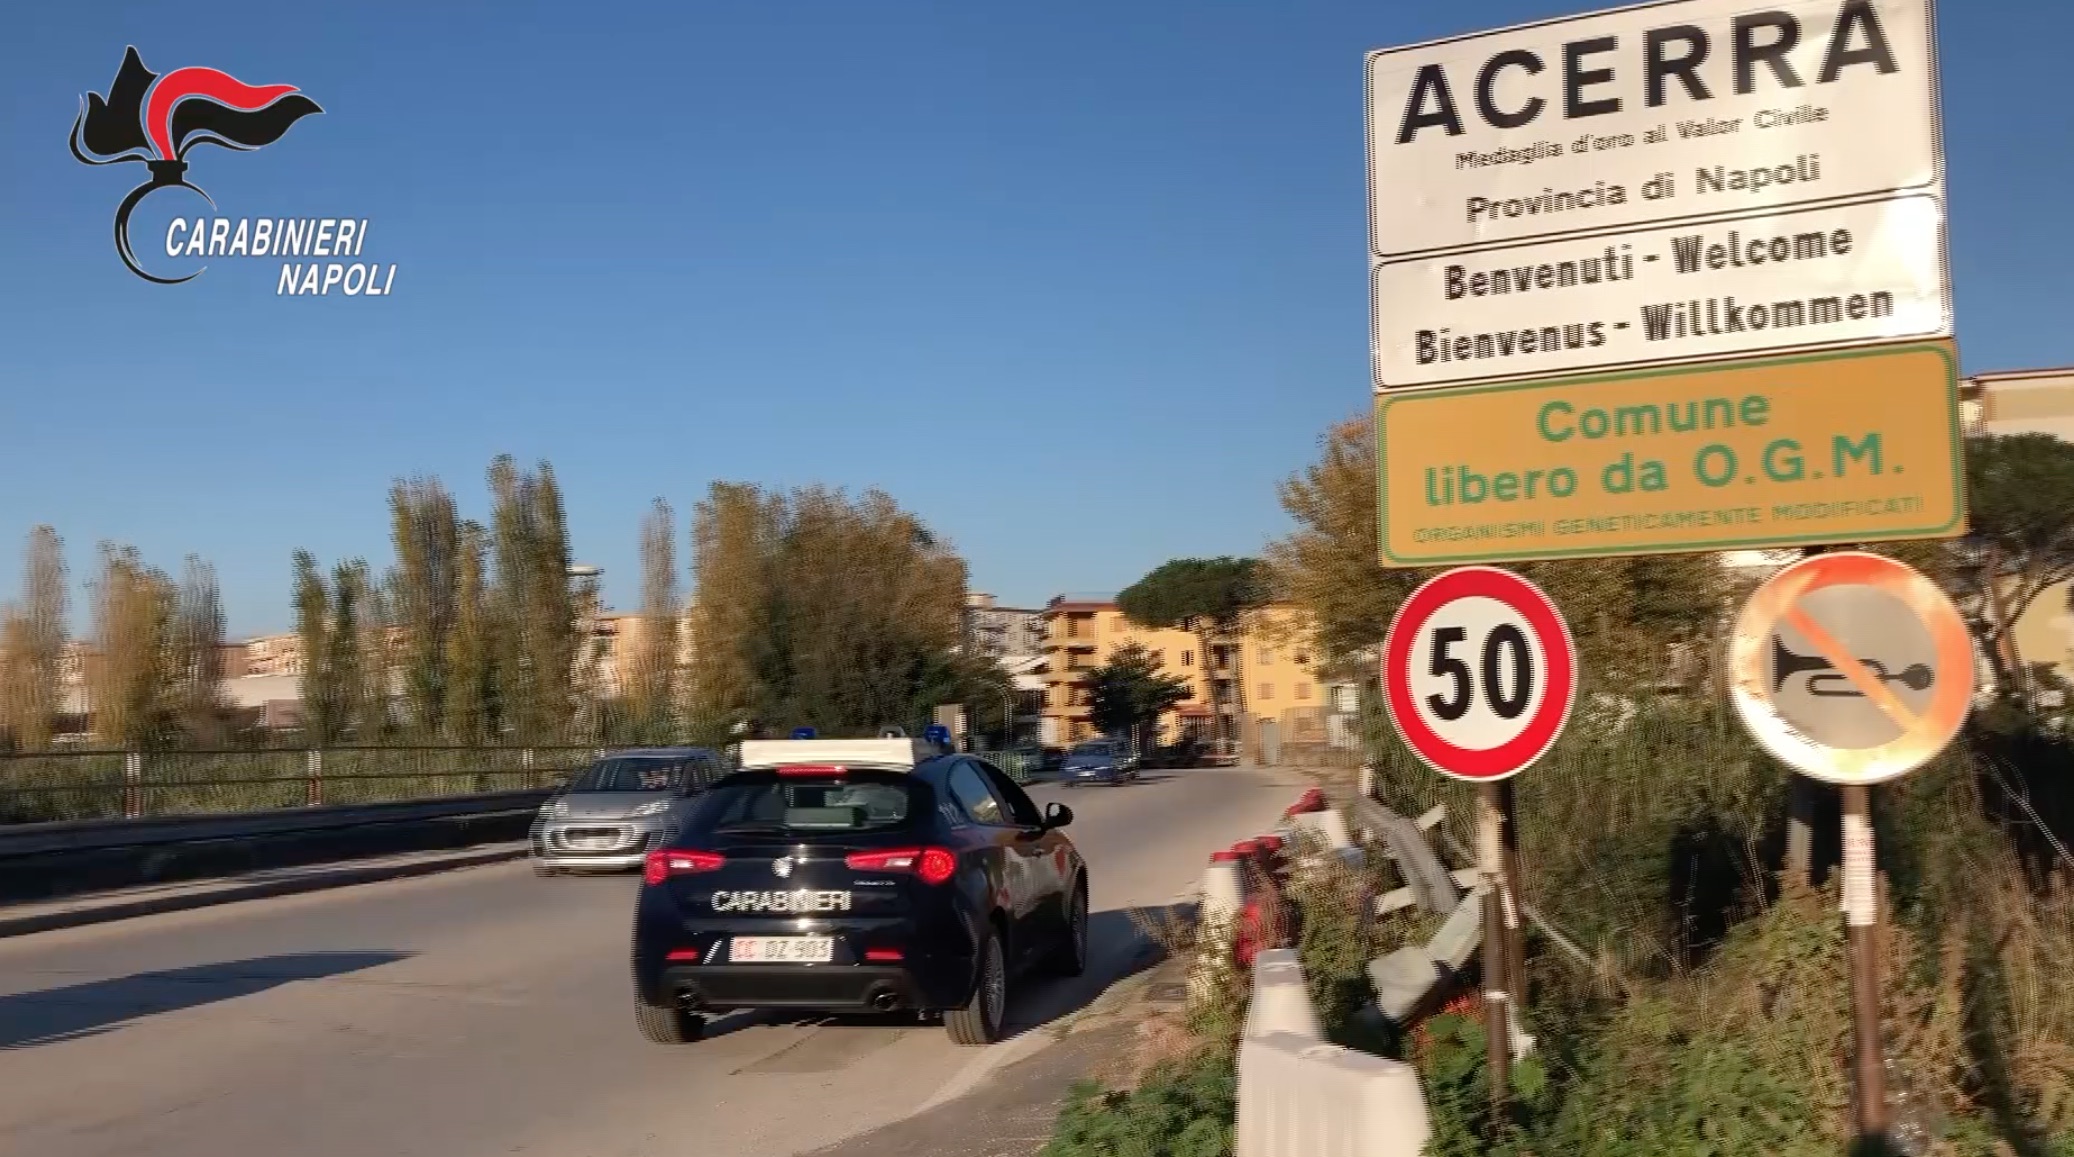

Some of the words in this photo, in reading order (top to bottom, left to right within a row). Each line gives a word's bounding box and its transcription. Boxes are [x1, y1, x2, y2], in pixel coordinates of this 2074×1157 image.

[1394, 0, 1900, 145] ACERRA
[1455, 140, 1563, 170] Medaglia
[1571, 134, 1634, 154] d'oro
[1643, 124, 1668, 144] al
[1676, 117, 1743, 139] Valor
[1753, 104, 1830, 129] Civile
[1466, 180, 1628, 223] Provincia
[1641, 171, 1675, 200] di
[1695, 153, 1820, 194] Napoli
[1444, 243, 1634, 301] Benvenuti
[1671, 227, 1853, 276] Welcome
[1416, 318, 1605, 366] Bienvenus
[1640, 289, 1894, 342] Willkommen
[1537, 394, 1771, 443] Comune
[1424, 464, 1578, 508] libero
[1600, 452, 1669, 495] da
[1693, 431, 1905, 489] O.G.M.
[1412, 521, 1545, 543] ORGANISMI
[1552, 507, 1761, 535] GENETICAMENTE
[1771, 495, 1924, 521] MODIFICATI
[1426, 623, 1534, 721] 50
[711, 889, 852, 913] CARABINIERI
[765, 939, 789, 960] DZ
[794, 939, 830, 960] 903
